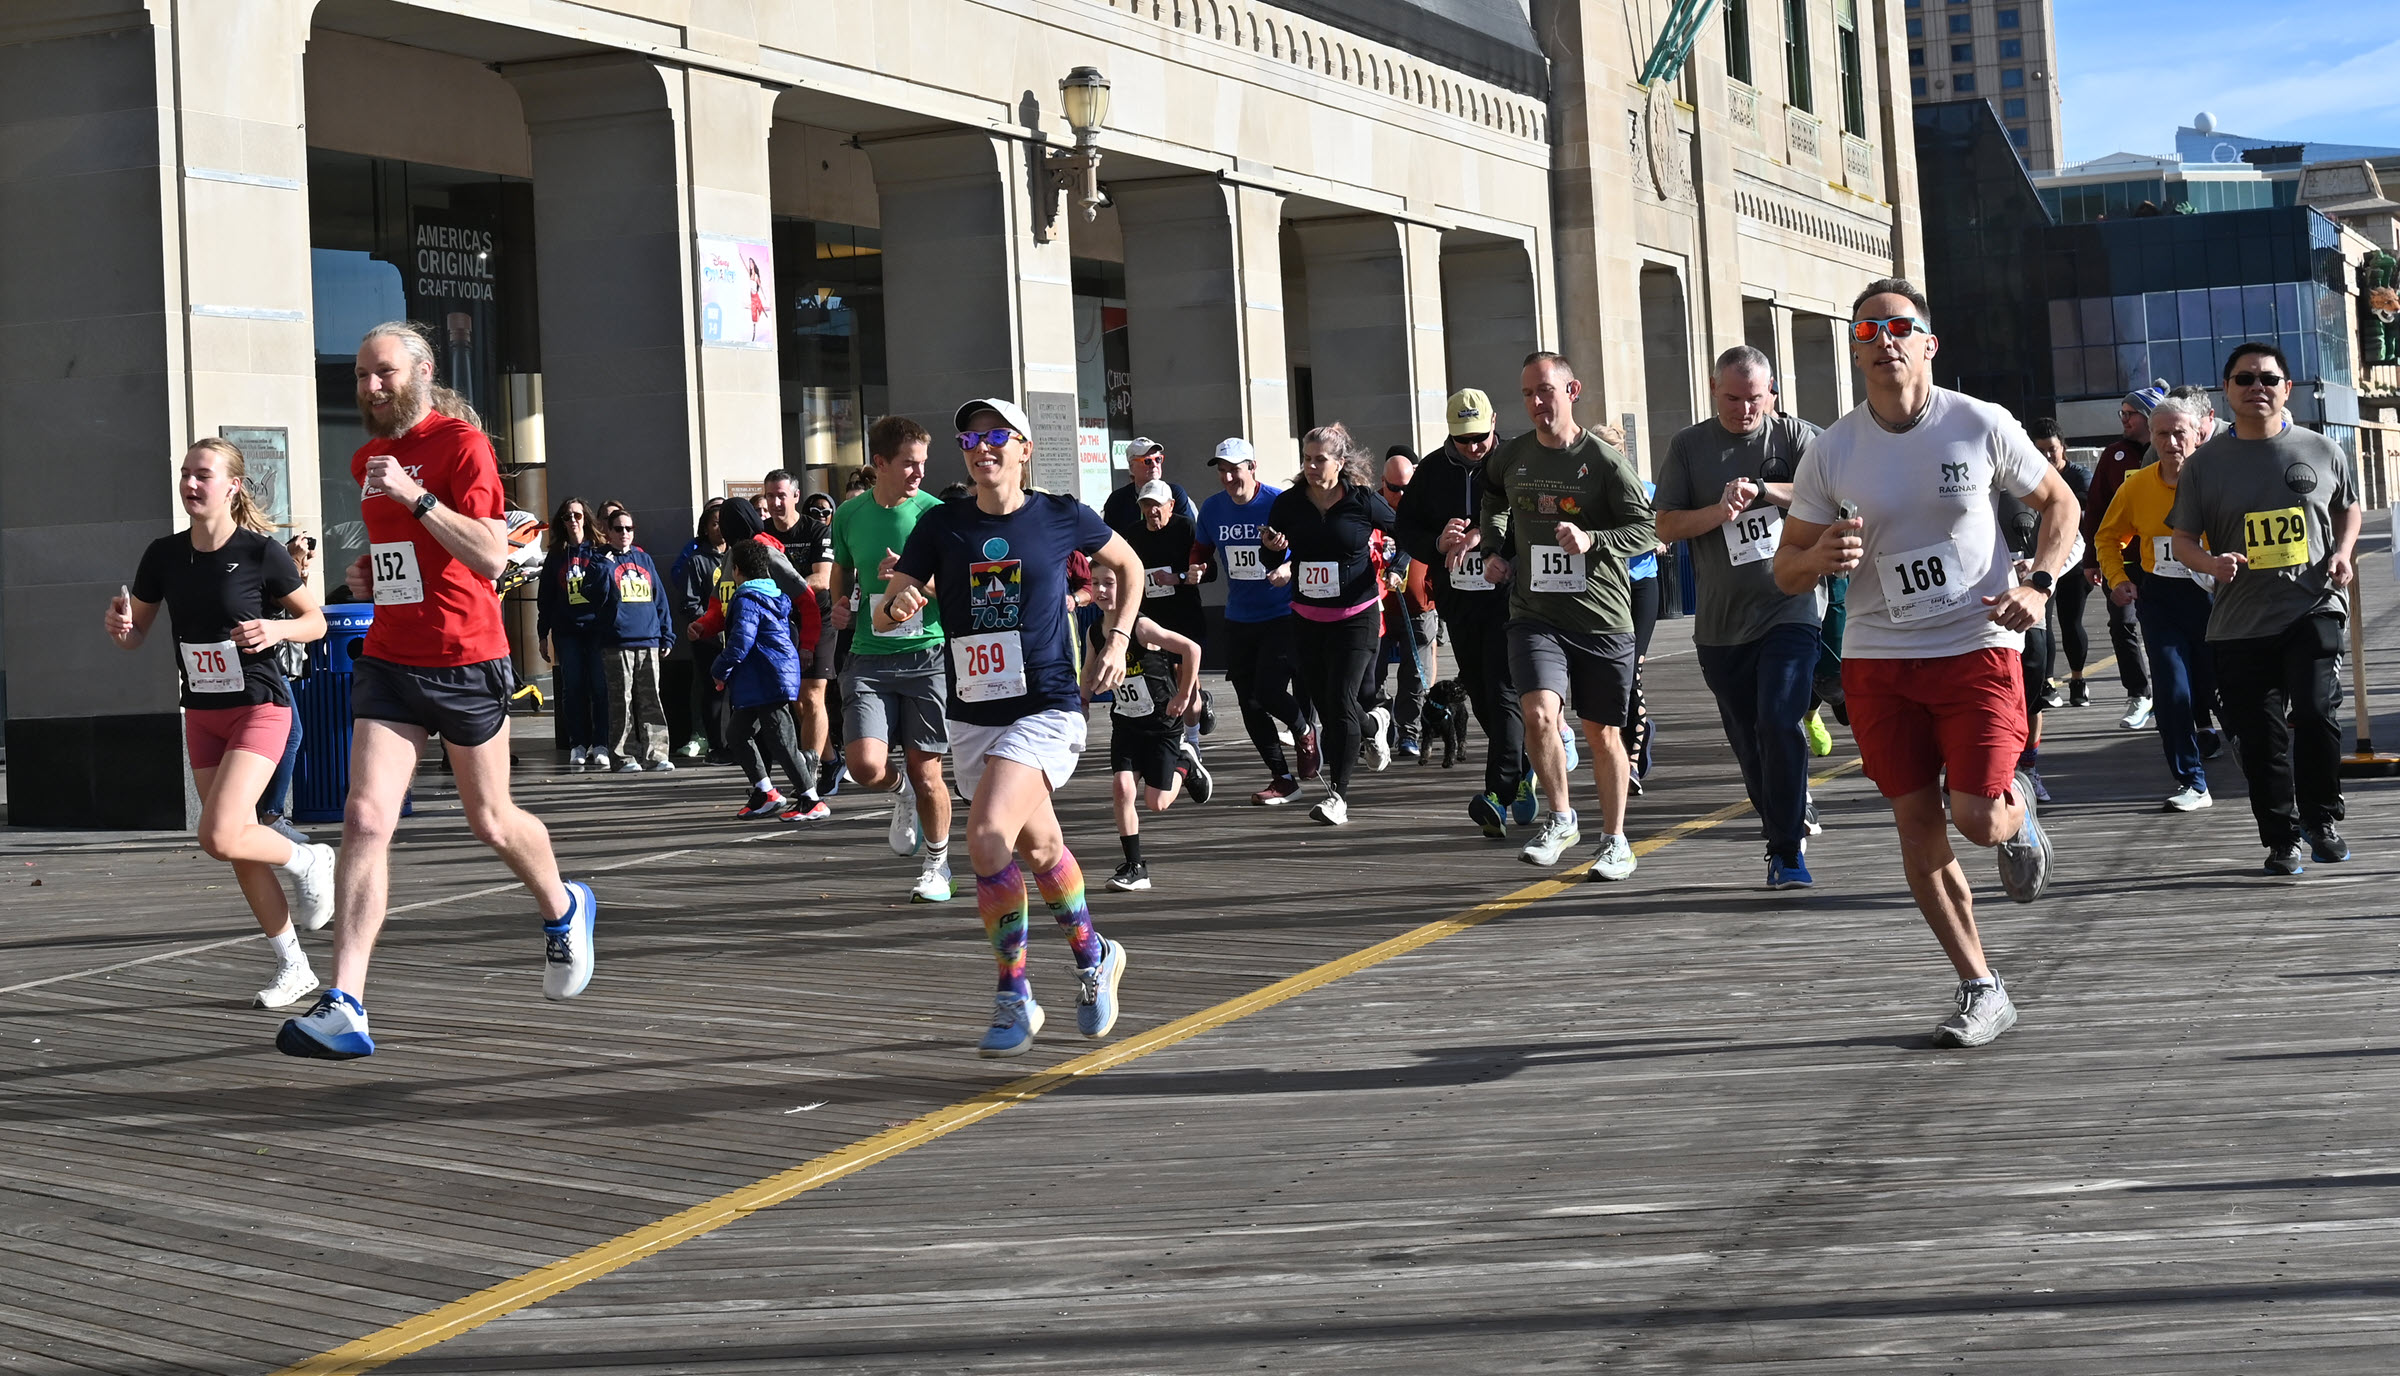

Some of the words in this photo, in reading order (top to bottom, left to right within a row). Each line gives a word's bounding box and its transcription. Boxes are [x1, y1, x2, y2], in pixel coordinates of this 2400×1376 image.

[418, 249, 494, 278] ORIGINAL
[418, 278, 456, 297] CRAFT
[1122, 391, 1132, 415] P
[1939, 484, 1977, 493] RAGNAR
[1736, 515, 1772, 544] 161
[2246, 515, 2305, 547] 1129
[374, 552, 406, 581] 152
[1234, 551, 1255, 566] 150
[1459, 558, 1483, 575] 149
[1542, 553, 1573, 574] 151
[1306, 567, 1329, 584] 270
[1895, 556, 1946, 595] 168
[971, 604, 1018, 629] 70.3
[192, 651, 226, 672] 276
[966, 643, 1005, 676] 269
